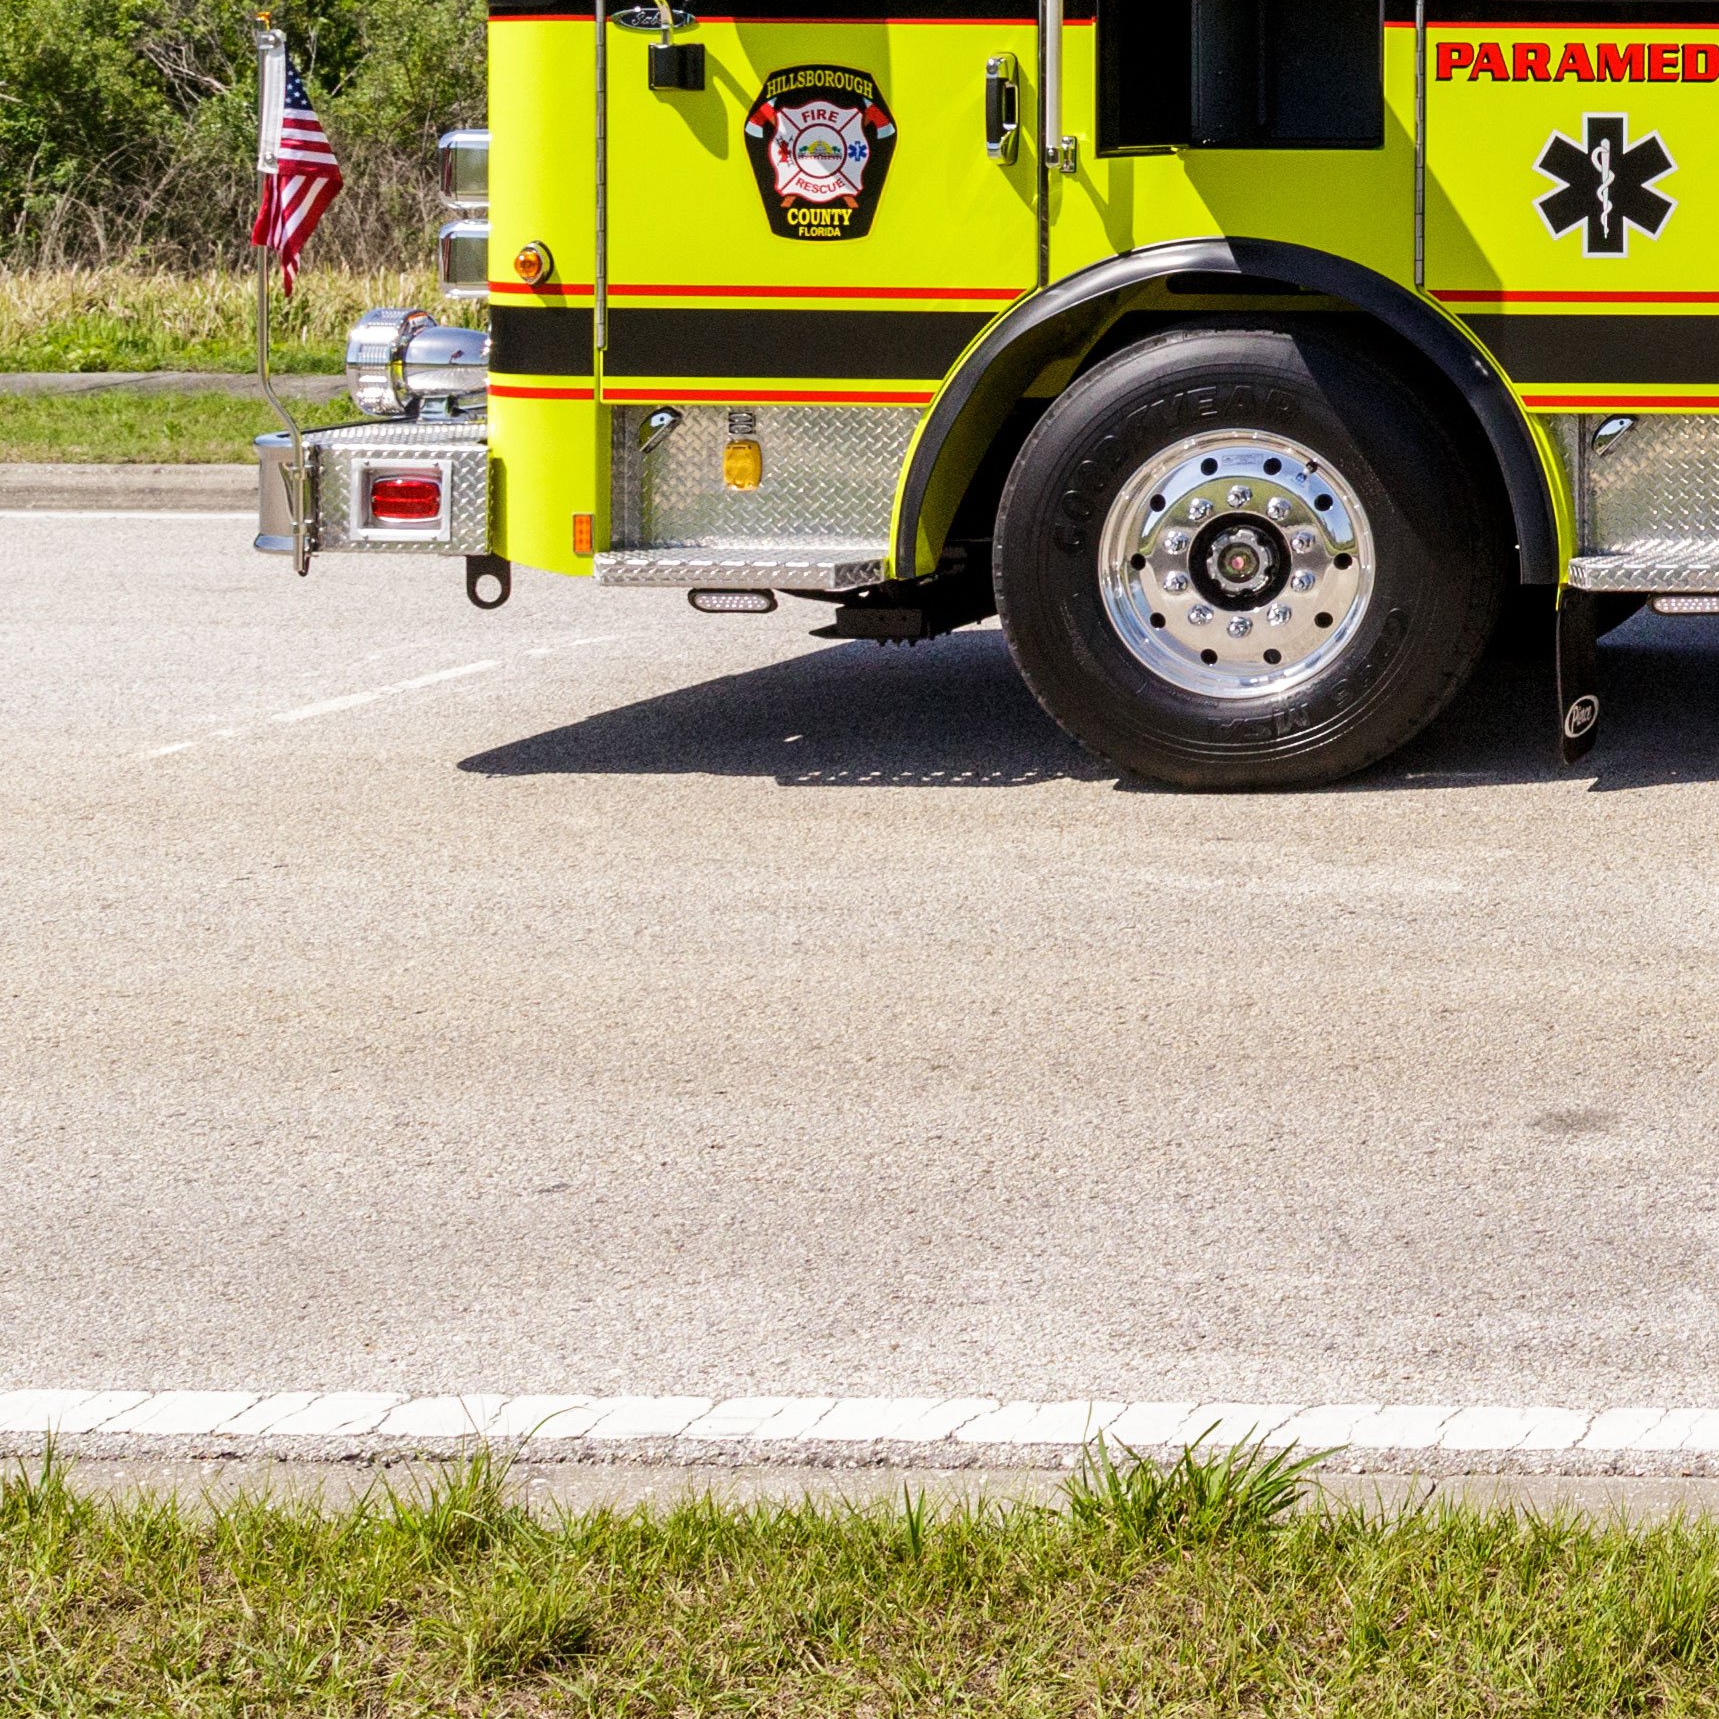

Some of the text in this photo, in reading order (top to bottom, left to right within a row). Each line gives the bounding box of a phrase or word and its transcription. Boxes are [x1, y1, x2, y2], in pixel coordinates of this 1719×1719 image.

[766, 70, 873, 98] HILLSBOROUGH
[801, 109, 839, 124] FIRE
[795, 177, 846, 195] RESCUE
[787, 208, 852, 226] COUNTY
[799, 227, 841, 237] FLORIDA
[1056, 384, 1301, 557] GOODYEAR
